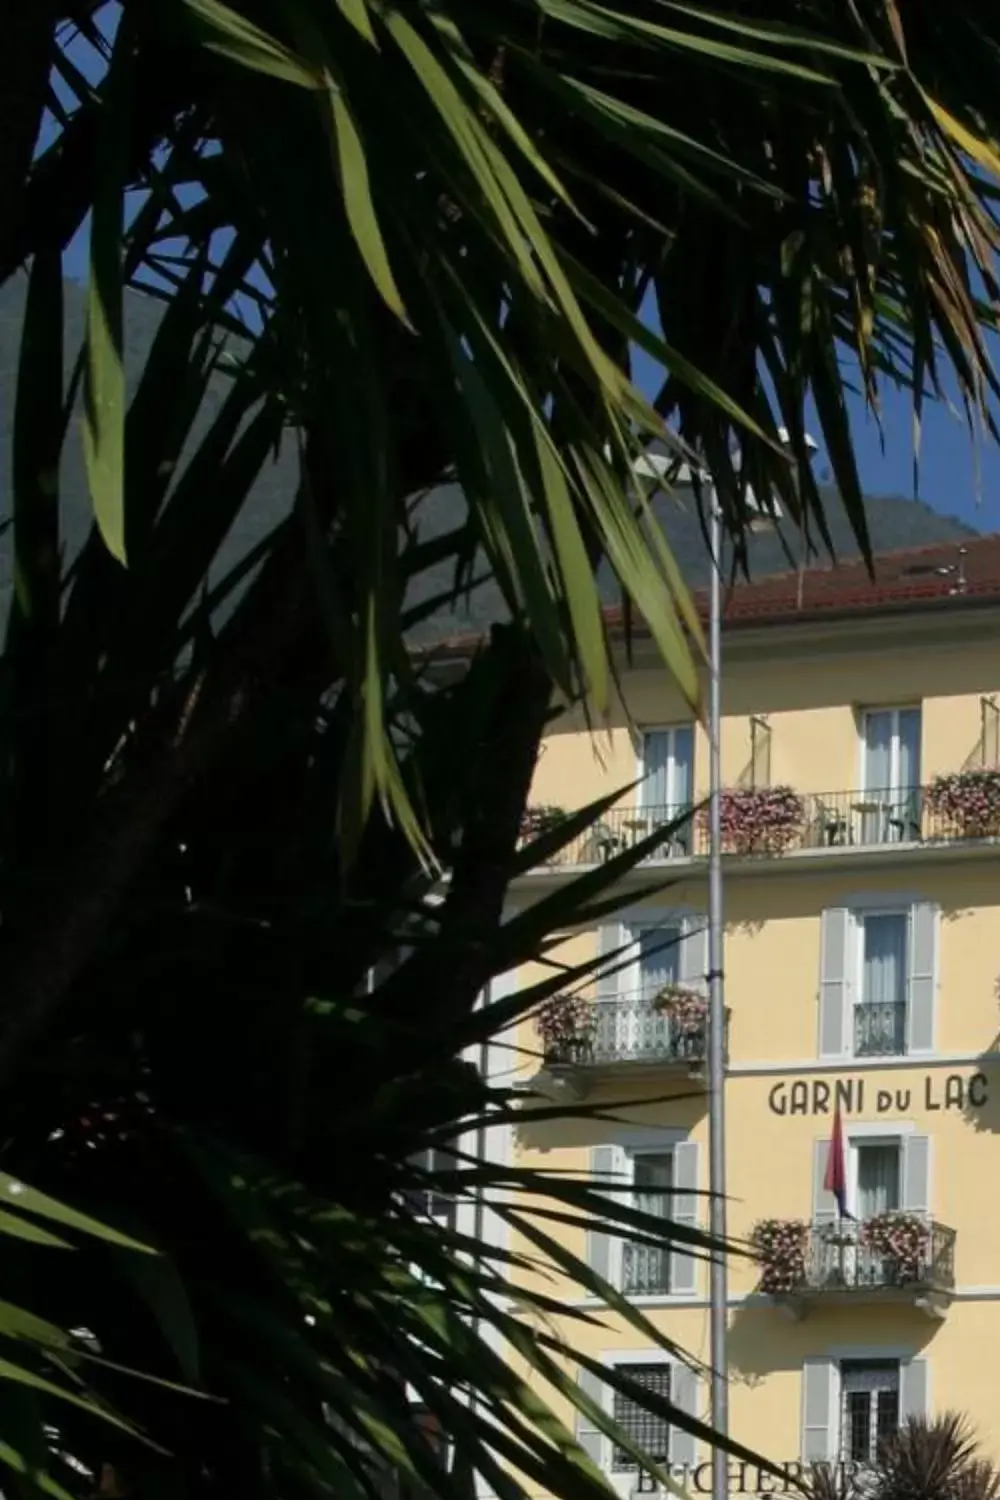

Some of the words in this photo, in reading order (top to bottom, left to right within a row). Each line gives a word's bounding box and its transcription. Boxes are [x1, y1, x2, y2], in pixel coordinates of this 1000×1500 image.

[768, 1078, 864, 1115] GARNI
[876, 1088, 912, 1113] DU
[924, 1072, 989, 1111] LAC
